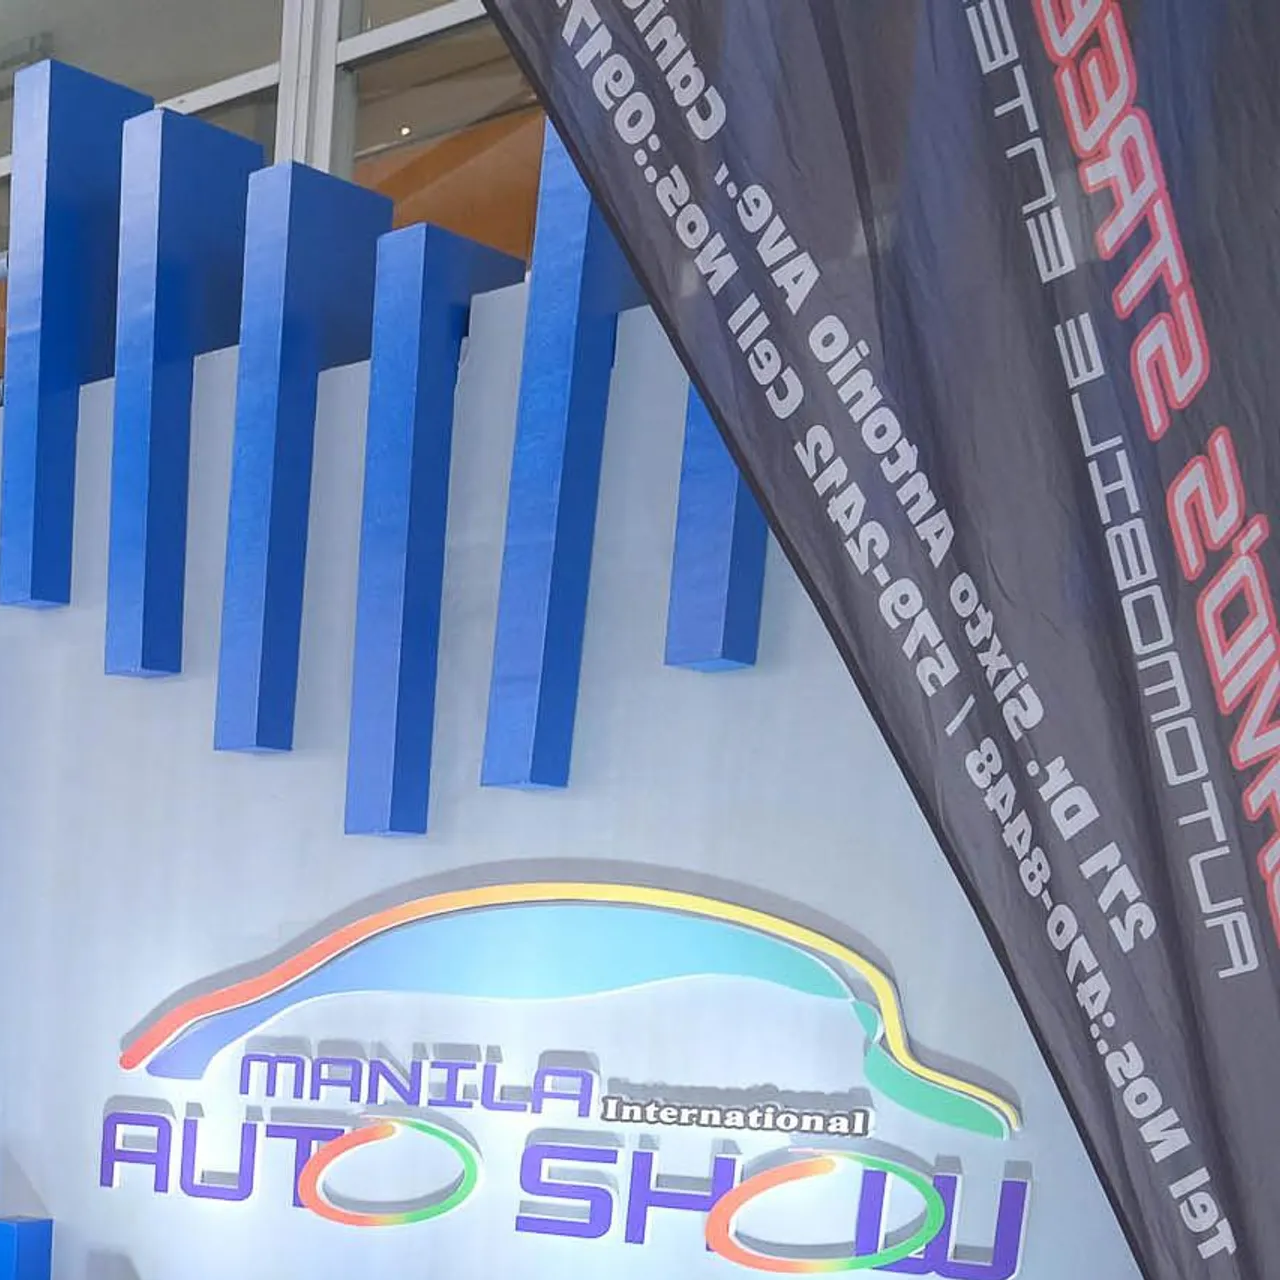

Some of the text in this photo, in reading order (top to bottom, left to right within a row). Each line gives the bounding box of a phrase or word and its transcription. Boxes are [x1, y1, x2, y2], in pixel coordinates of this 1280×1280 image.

[239, 1049, 871, 1139] MANILA International
[99, 1110, 480, 1228] AUTO
